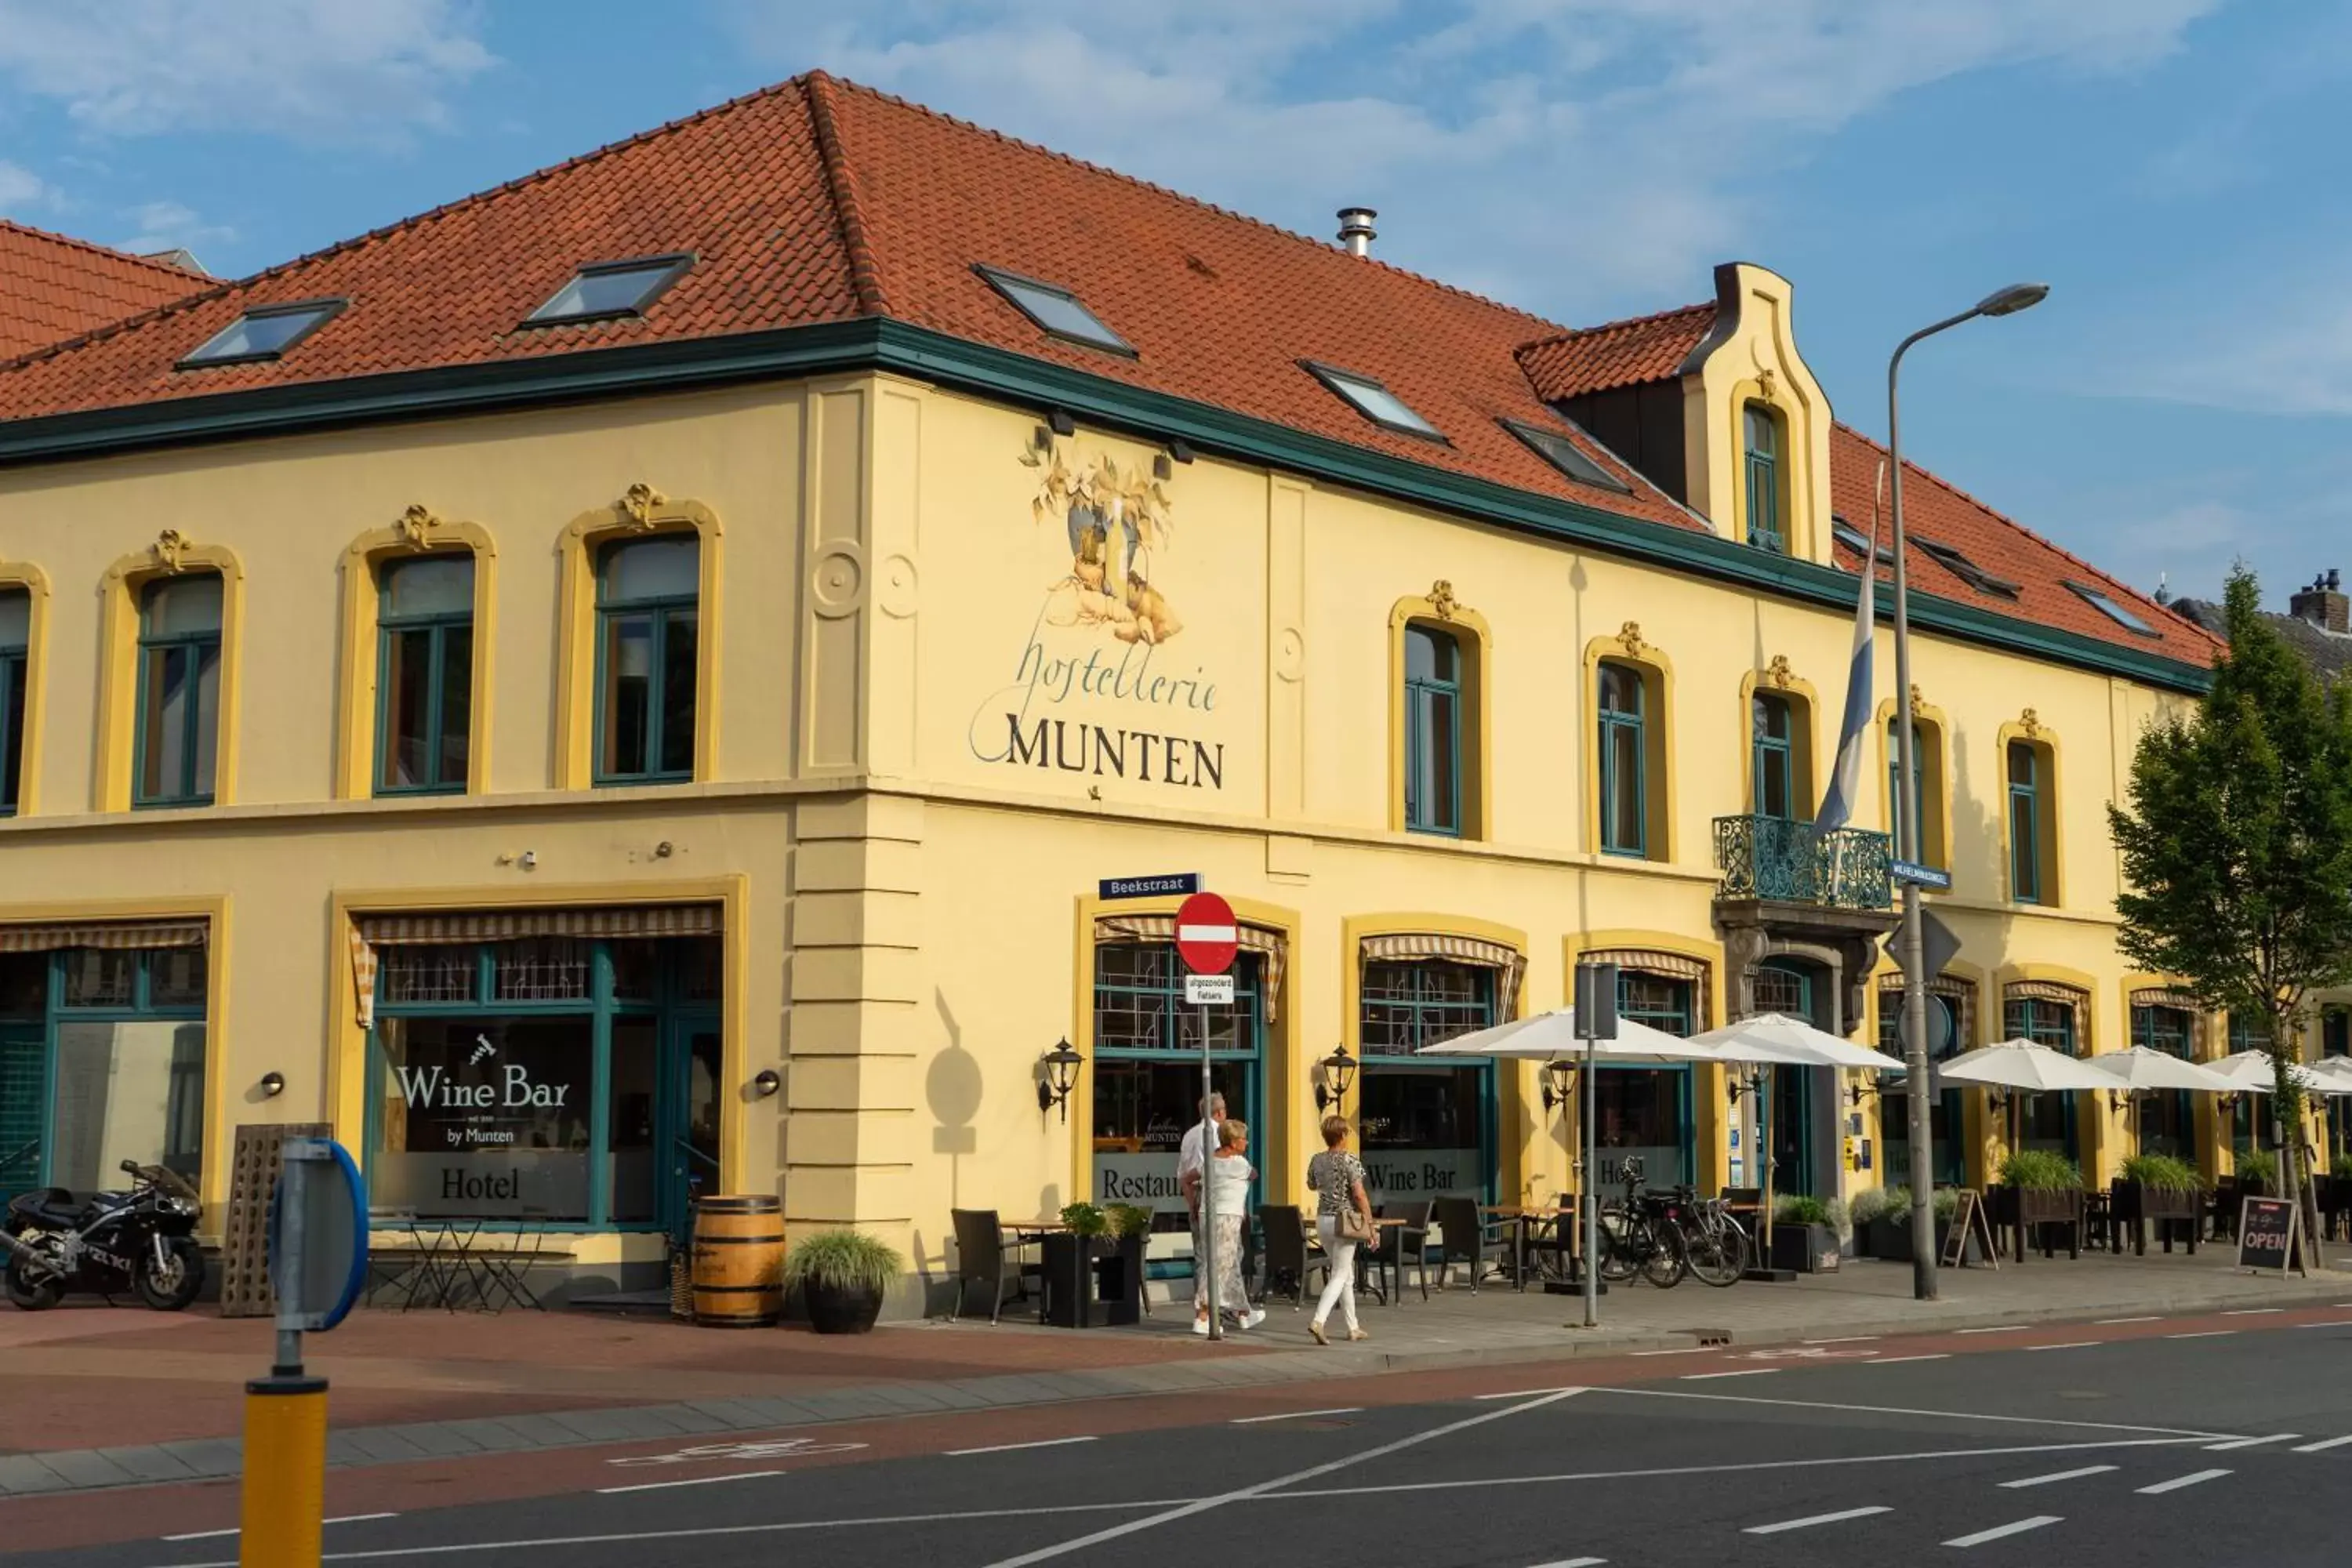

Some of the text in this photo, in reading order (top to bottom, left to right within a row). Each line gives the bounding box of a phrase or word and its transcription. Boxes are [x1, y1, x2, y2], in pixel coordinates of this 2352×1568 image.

[1006, 713, 1225, 790] MUNTEN
[1111, 878, 1185, 895] Beekstraat
[397, 1064, 570, 1109] Wine Bar
[447, 1128, 514, 1147] by Munten
[441, 1168, 519, 1200] Hotel
[1103, 1168, 1184, 1199] Restau
[1367, 1162, 1456, 1191] Wine Bar
[2245, 1231, 2287, 1251] OPEN
